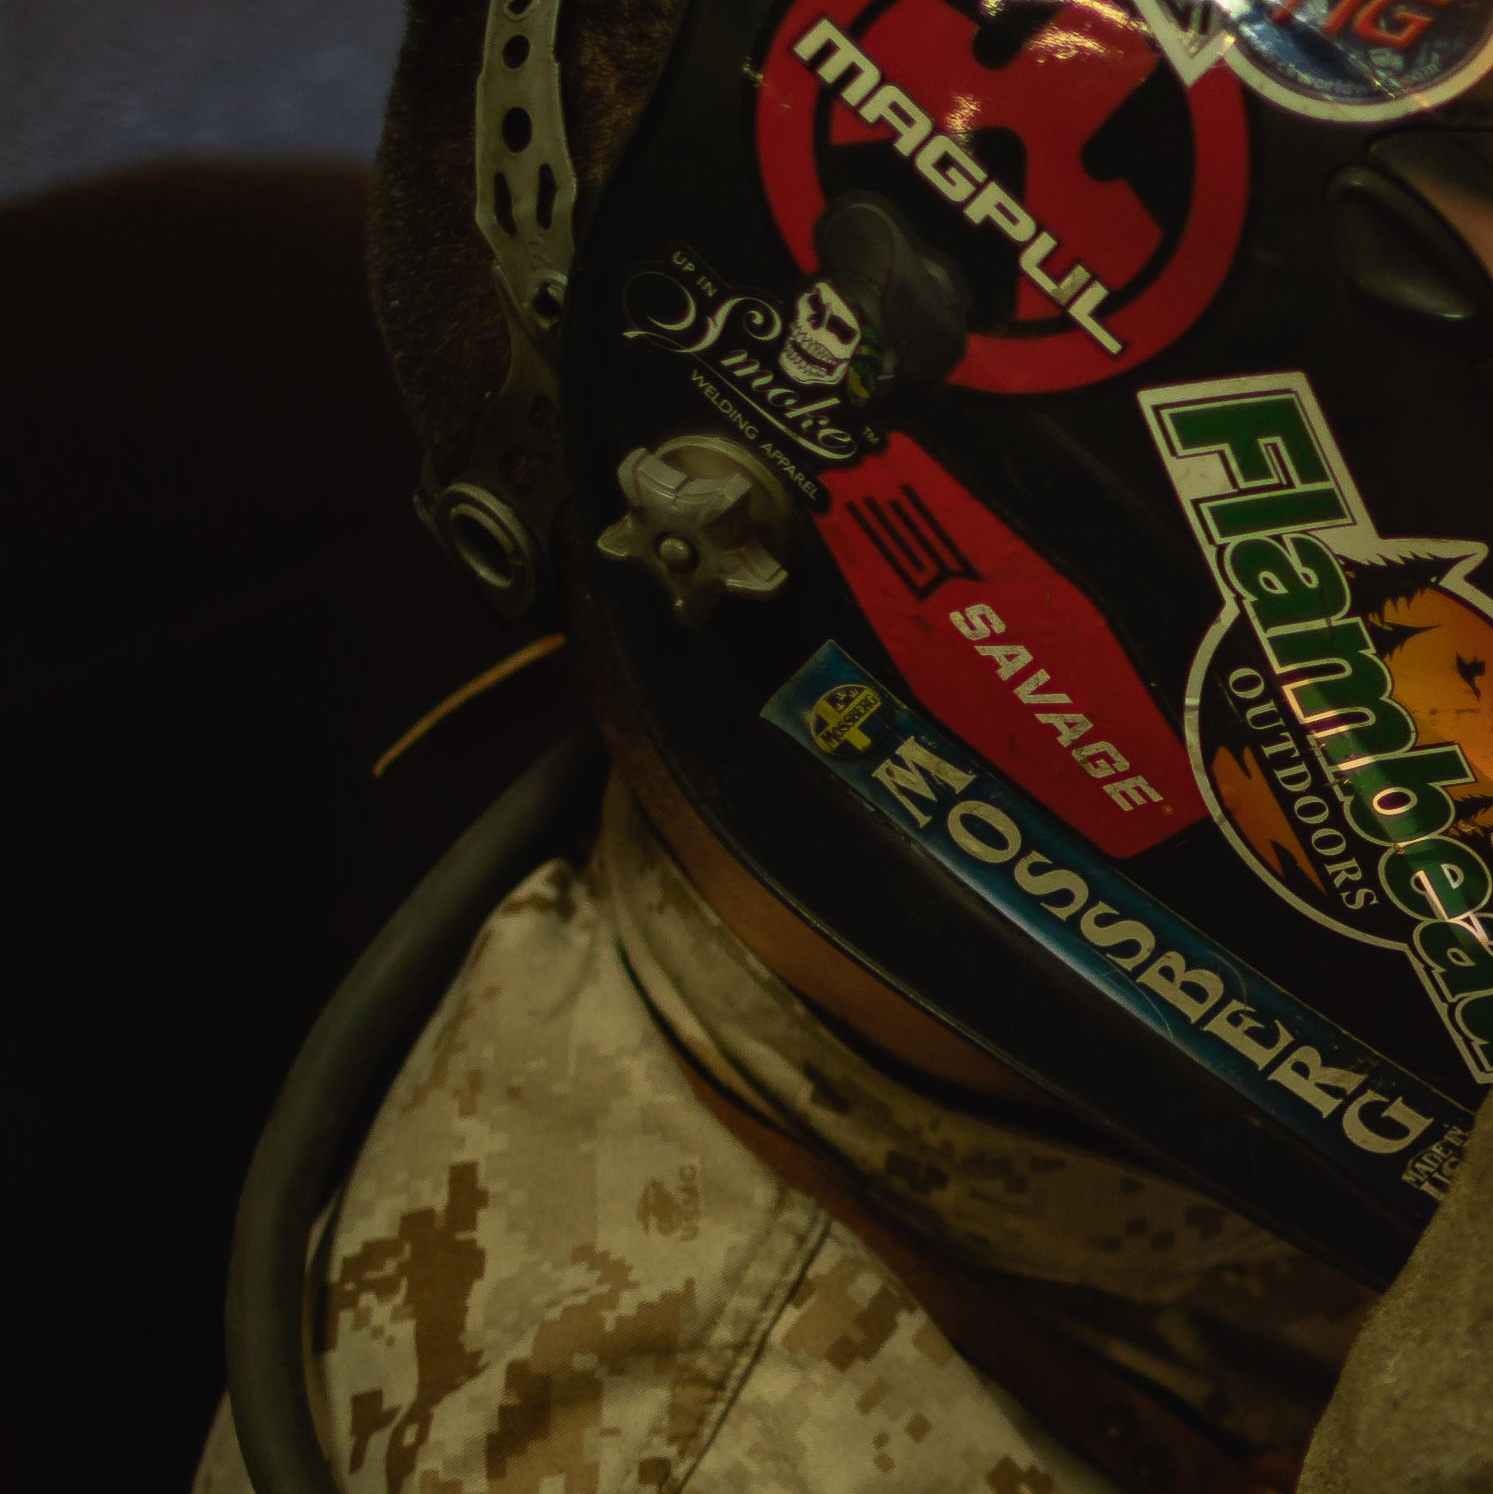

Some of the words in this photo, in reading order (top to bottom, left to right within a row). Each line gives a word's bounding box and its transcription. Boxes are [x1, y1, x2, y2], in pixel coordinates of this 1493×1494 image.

[672, 251, 696, 274] UP
[696, 276, 718, 299] IN
[792, 17, 1123, 356] MAGPUL
[622, 271, 858, 459] Smoke
[690, 368, 759, 441] WELDING
[759, 442, 818, 500] APPAREL
[949, 603, 1164, 812] SAVAGE
[1229, 666, 1379, 911] OUTDOORS
[872, 735, 1434, 1154] MOSSBERG
